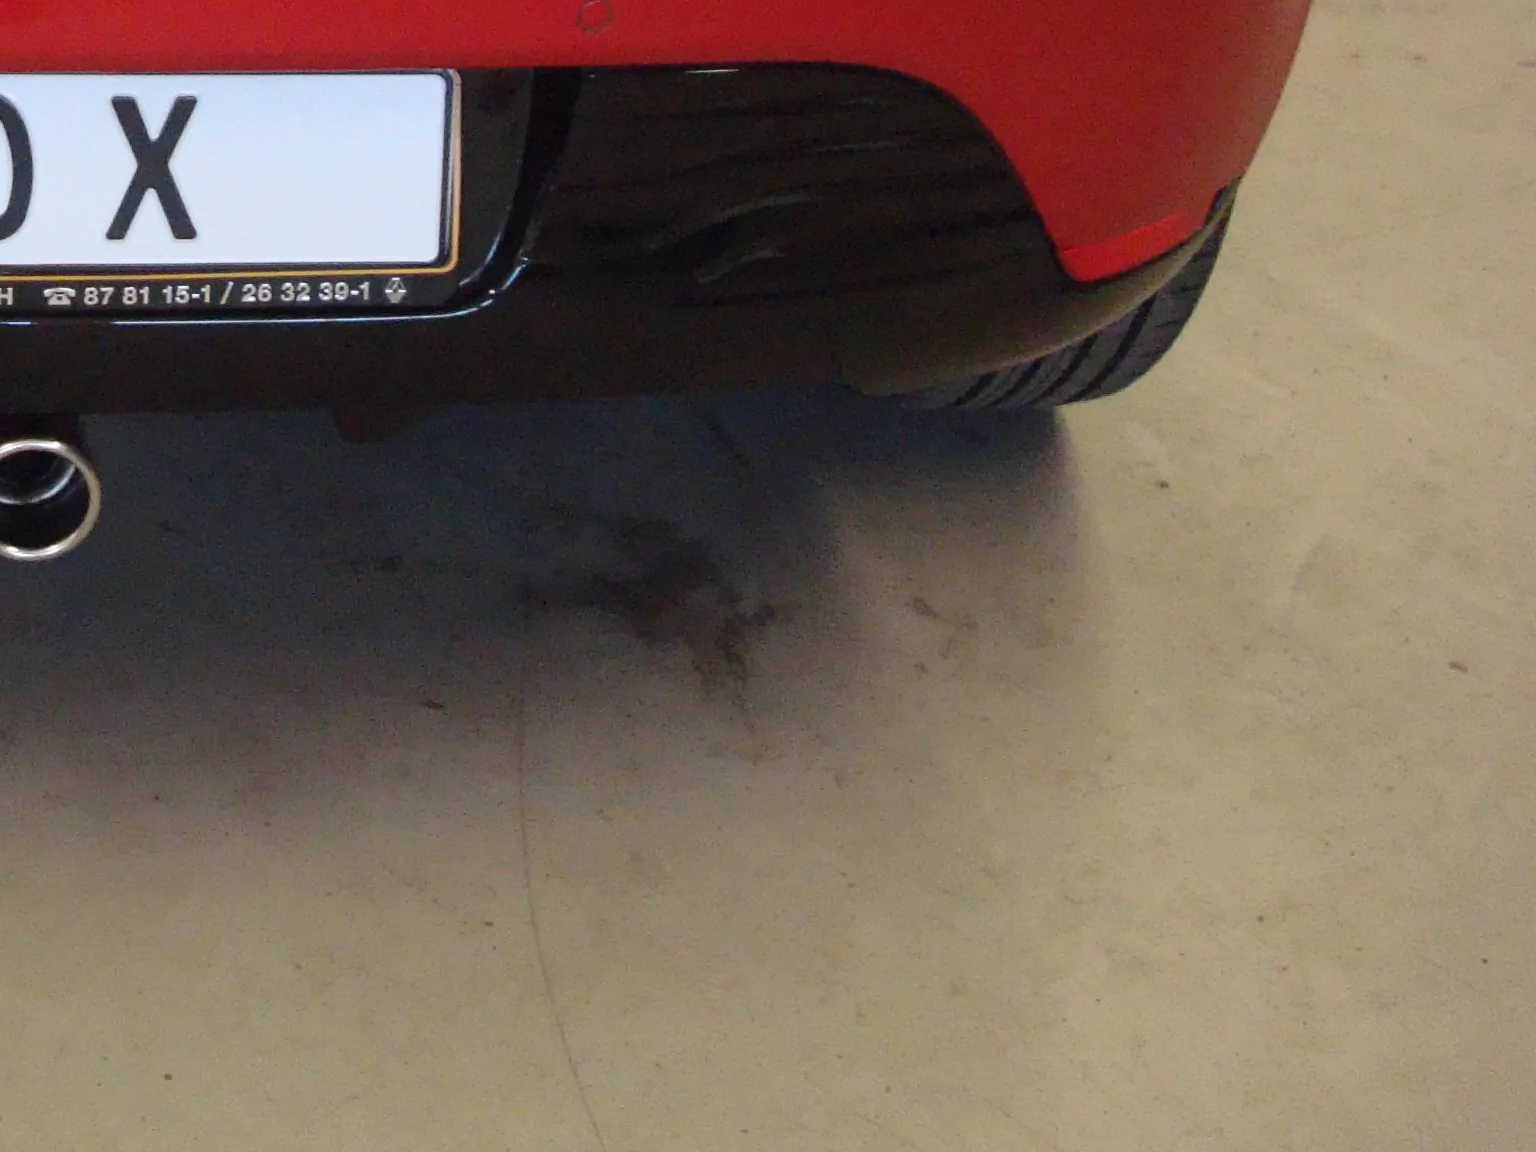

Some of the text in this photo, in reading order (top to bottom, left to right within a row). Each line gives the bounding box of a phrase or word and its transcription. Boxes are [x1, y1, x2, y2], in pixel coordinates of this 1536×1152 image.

[82, 286, 114, 306] 87
[122, 285, 150, 305] 81
[161, 284, 212, 305] 15-1
[240, 283, 272, 303] 26
[279, 282, 311, 303] 32
[317, 281, 371, 303] 39-1
